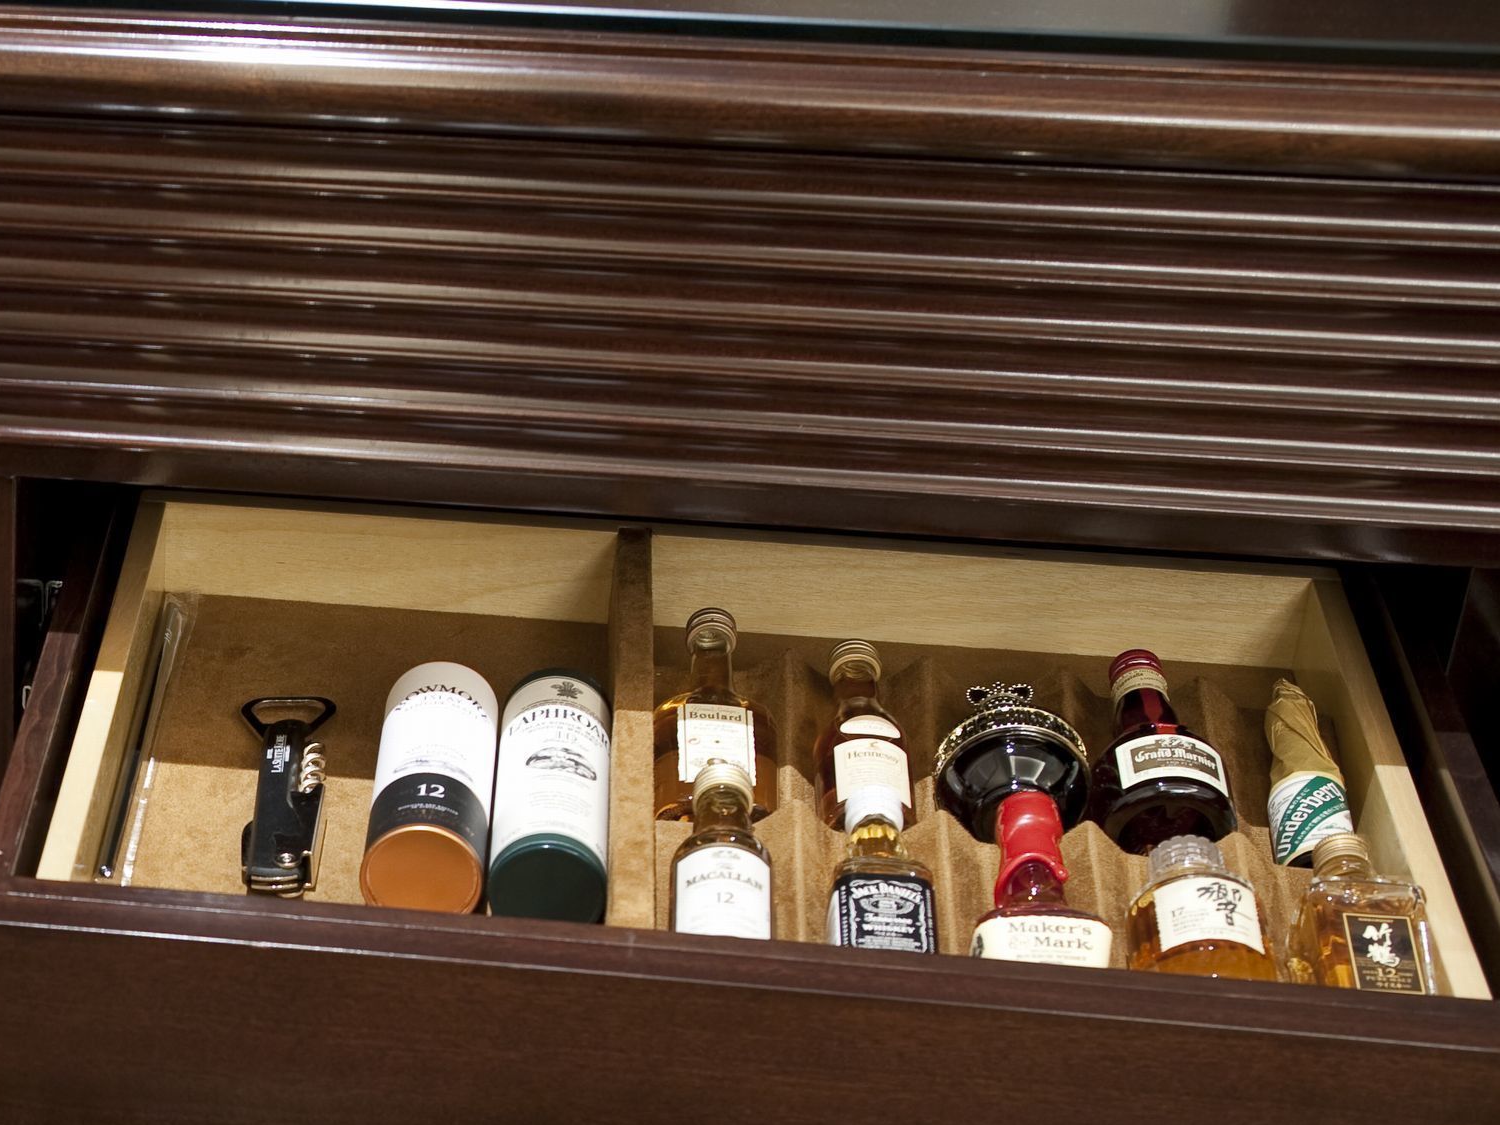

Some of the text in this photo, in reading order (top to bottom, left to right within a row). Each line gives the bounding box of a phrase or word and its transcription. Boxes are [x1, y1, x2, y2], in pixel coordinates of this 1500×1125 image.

[395, 684, 487, 718] OWMOR
[689, 711, 742, 722] Boulard
[1134, 747, 1217, 770] Grand Marnier
[416, 783, 446, 798] 12
[1276, 782, 1345, 858] Underberg
[685, 870, 764, 892] MACALLAN
[715, 891, 735, 904] 12
[1007, 921, 1093, 936] Maker's
[1376, 968, 1400, 978] 12
